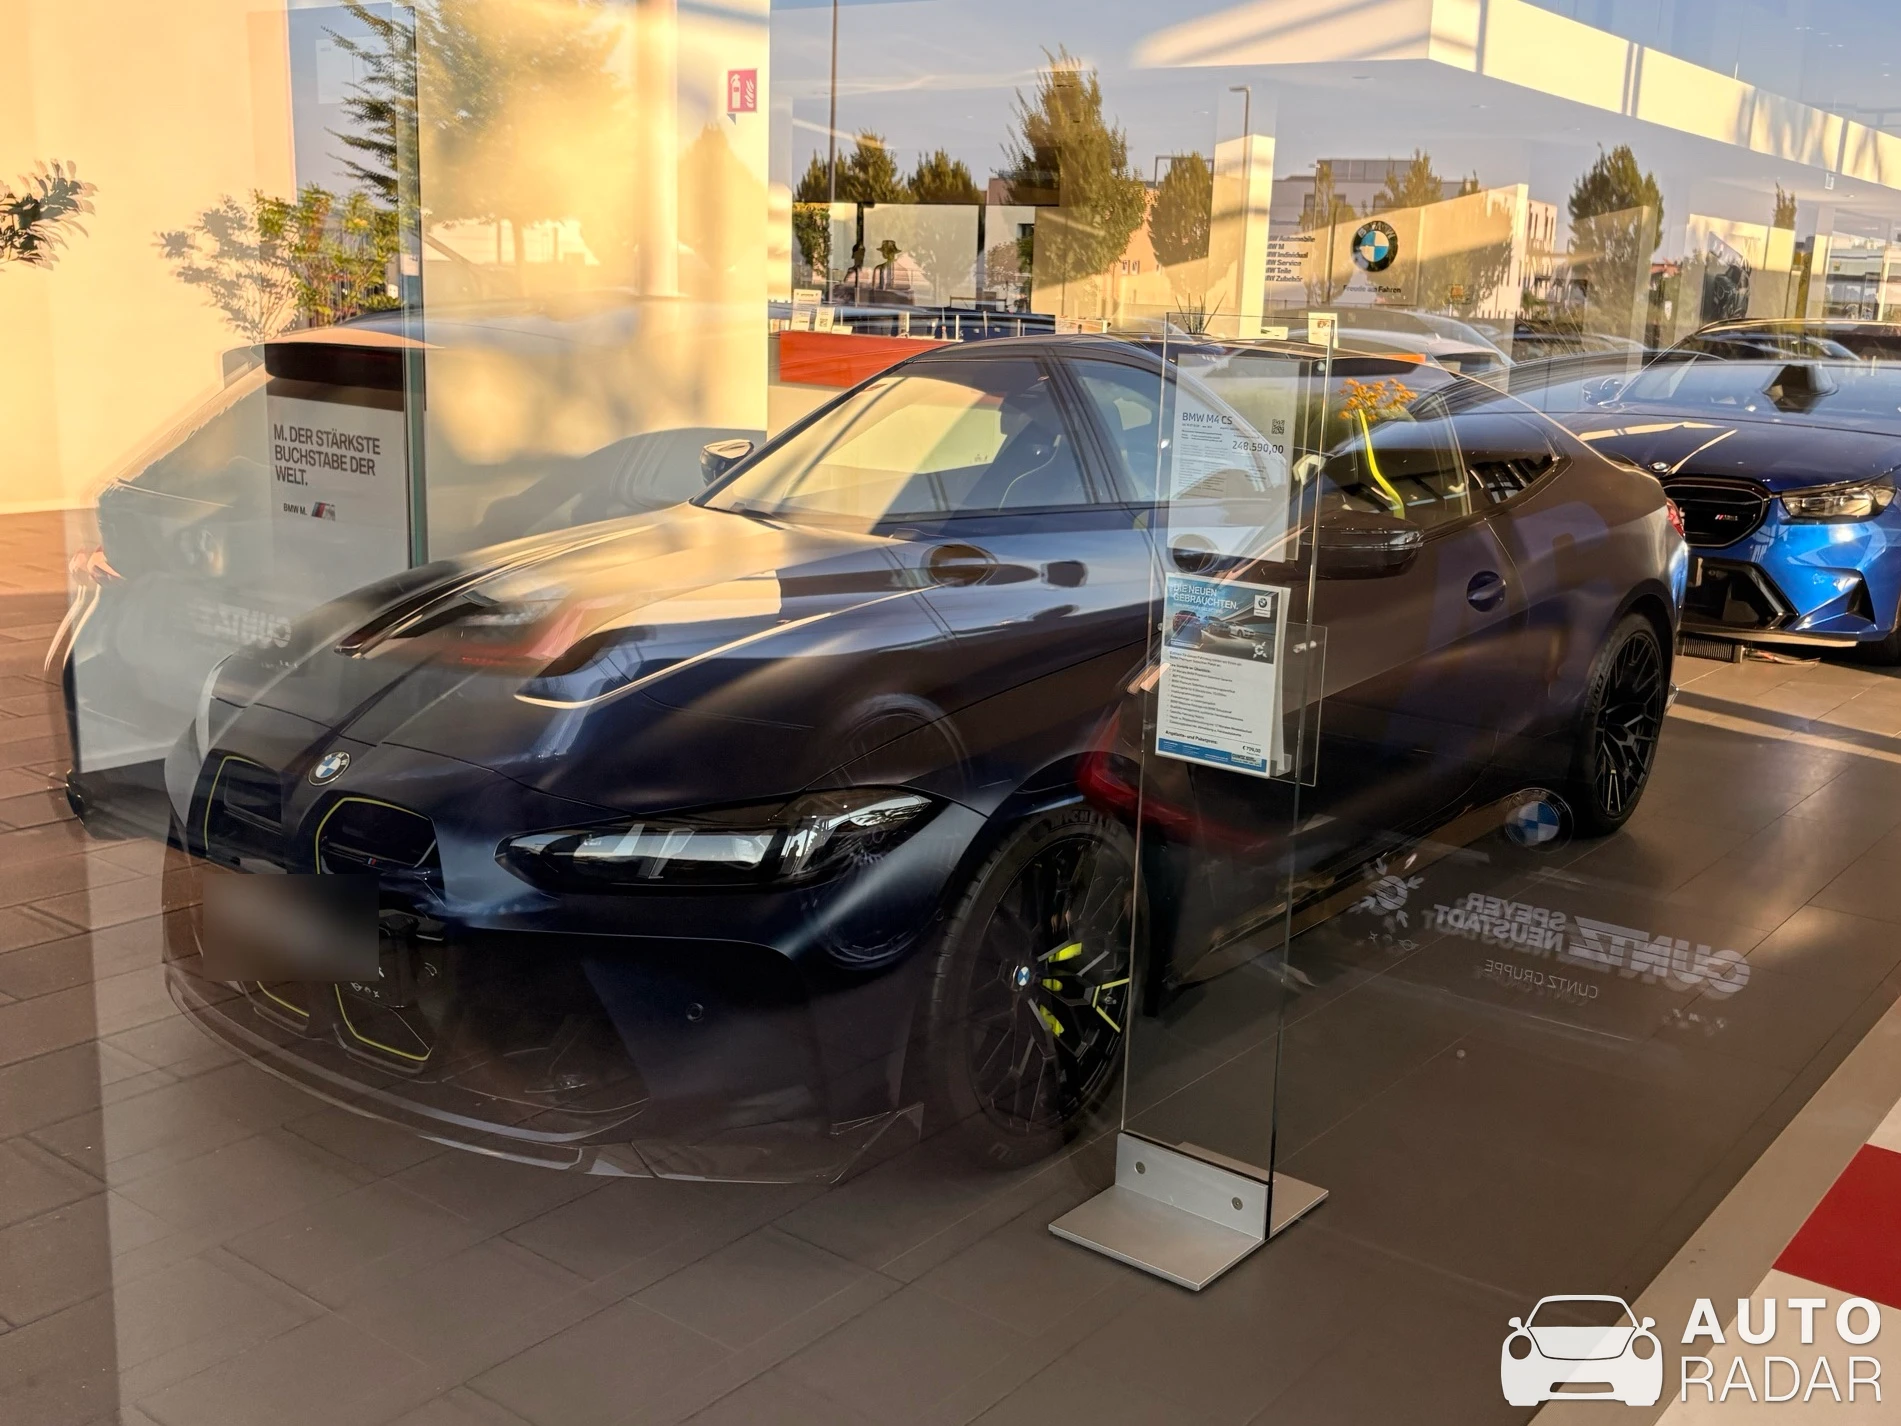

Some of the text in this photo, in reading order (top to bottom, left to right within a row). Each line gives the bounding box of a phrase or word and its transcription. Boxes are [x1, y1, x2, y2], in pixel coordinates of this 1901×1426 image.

[1378, 285, 1401, 293] Fahren
[1182, 412, 1233, 425] BMW M4 CS
[274, 424, 381, 455] M. DER STÄRKSTE
[1232, 441, 1284, 455] 248.590,00
[275, 444, 376, 476] BUCHSTABE DER
[275, 465, 308, 486] WELT.
[283, 503, 308, 516] BMW M.
[1174, 584, 1217, 596] DIE NEUEN
[1174, 592, 1239, 610] GEBRAUCHTEN.
